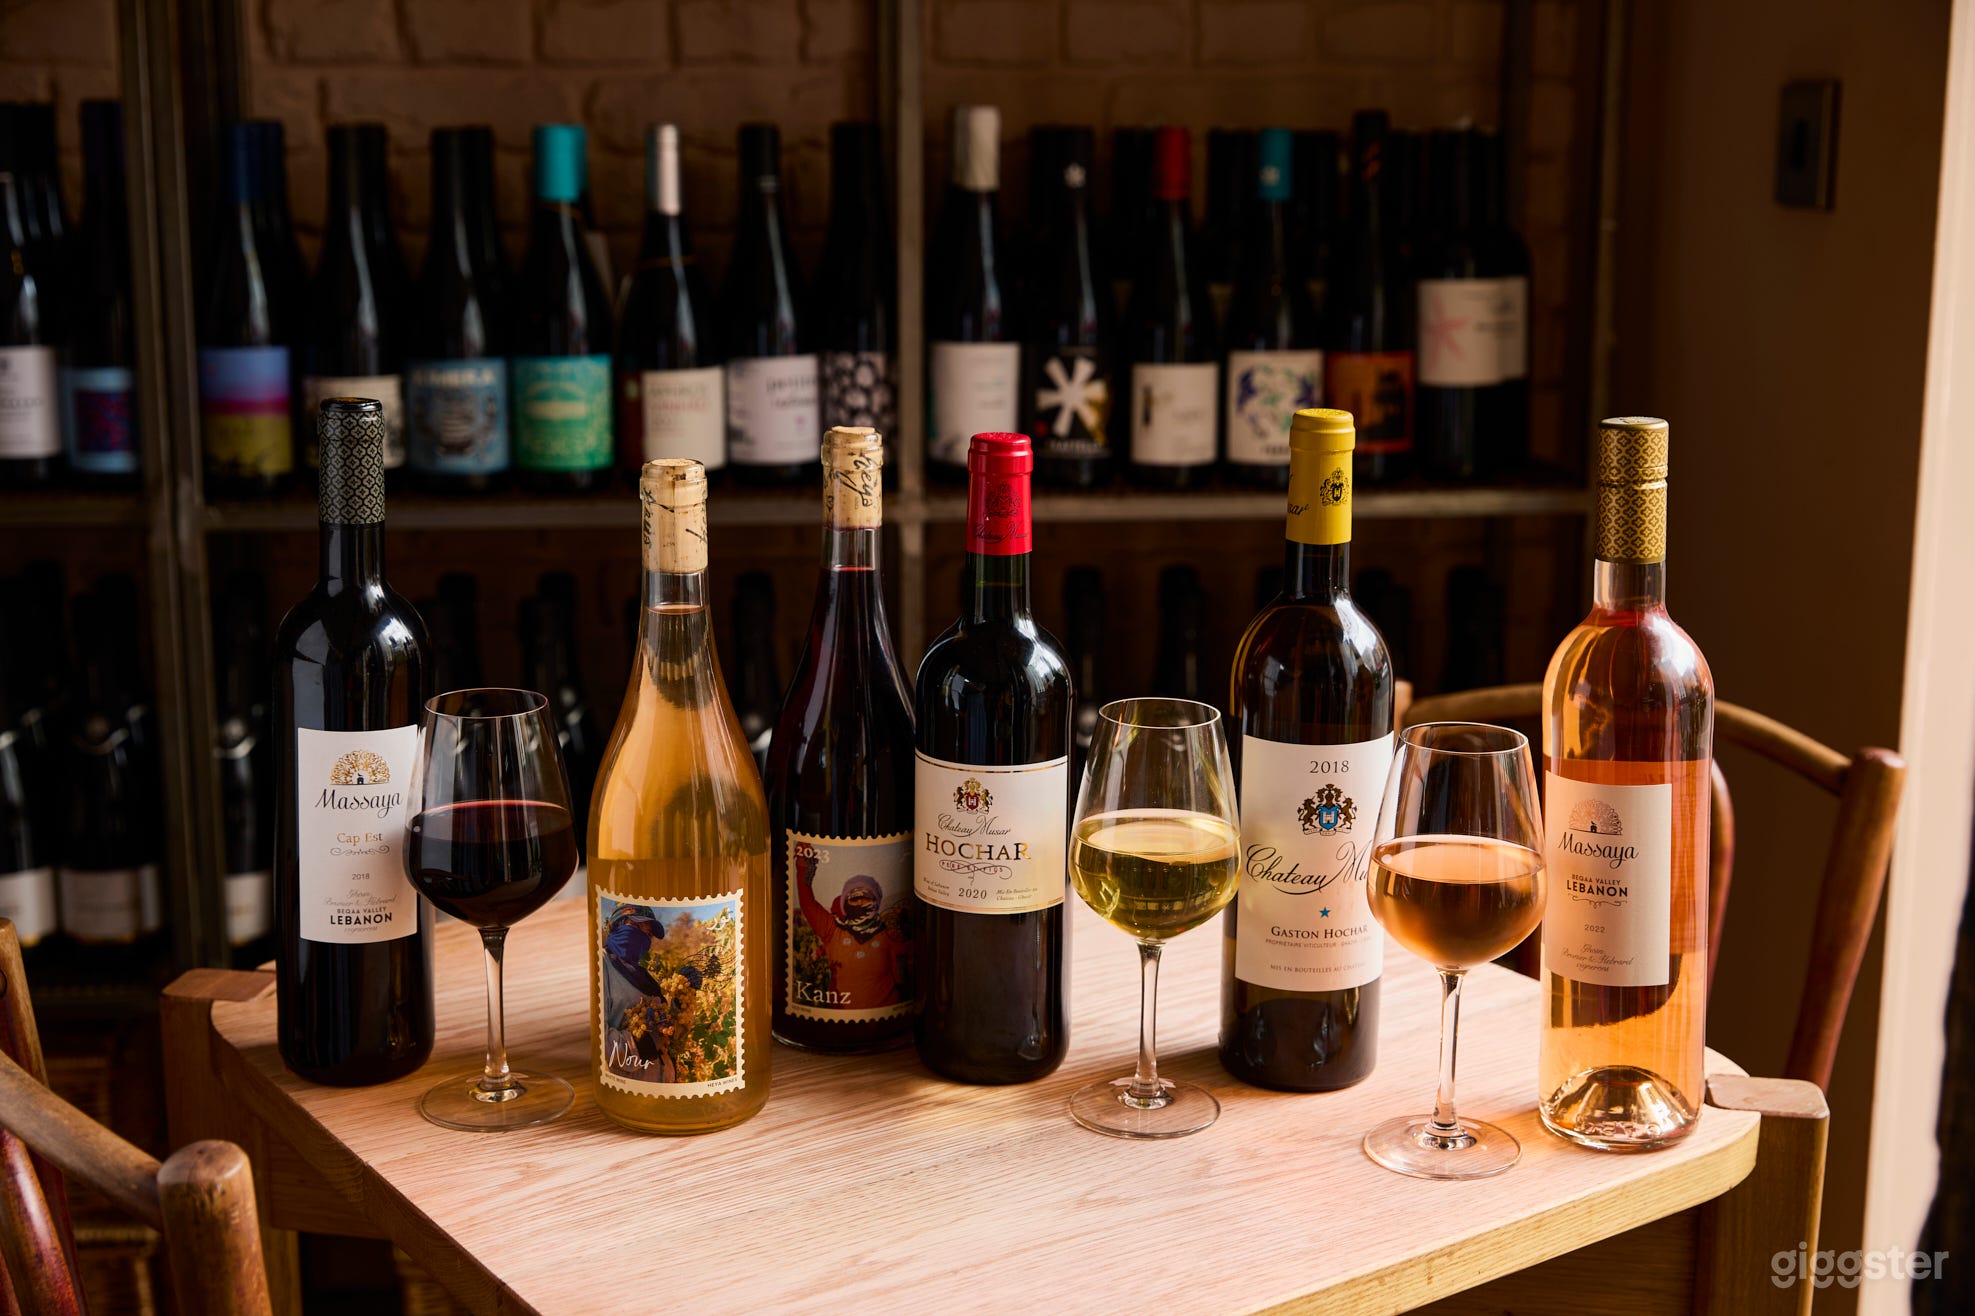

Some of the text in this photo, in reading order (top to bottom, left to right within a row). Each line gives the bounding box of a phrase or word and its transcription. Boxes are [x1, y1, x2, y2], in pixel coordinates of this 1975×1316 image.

[1309, 760, 1349, 774] 2018
[314, 788, 402, 819] Massaya
[336, 832, 383, 847] Cap Est
[925, 832, 1032, 861] HOCHAR
[796, 846, 831, 864] 2023
[1558, 832, 1640, 870] Massaya
[351, 872, 370, 881] 2018
[1246, 844, 1328, 896] Chateau
[1566, 880, 1629, 898] LEBANON
[1595, 878, 1621, 886] VALLEY
[958, 887, 988, 900] 2020
[362, 906, 388, 914] VALLEY
[330, 912, 393, 926] LEBANON
[1584, 924, 1606, 934] 2022
[796, 981, 852, 1005] Kanz
[608, 1040, 656, 1070] Nour
